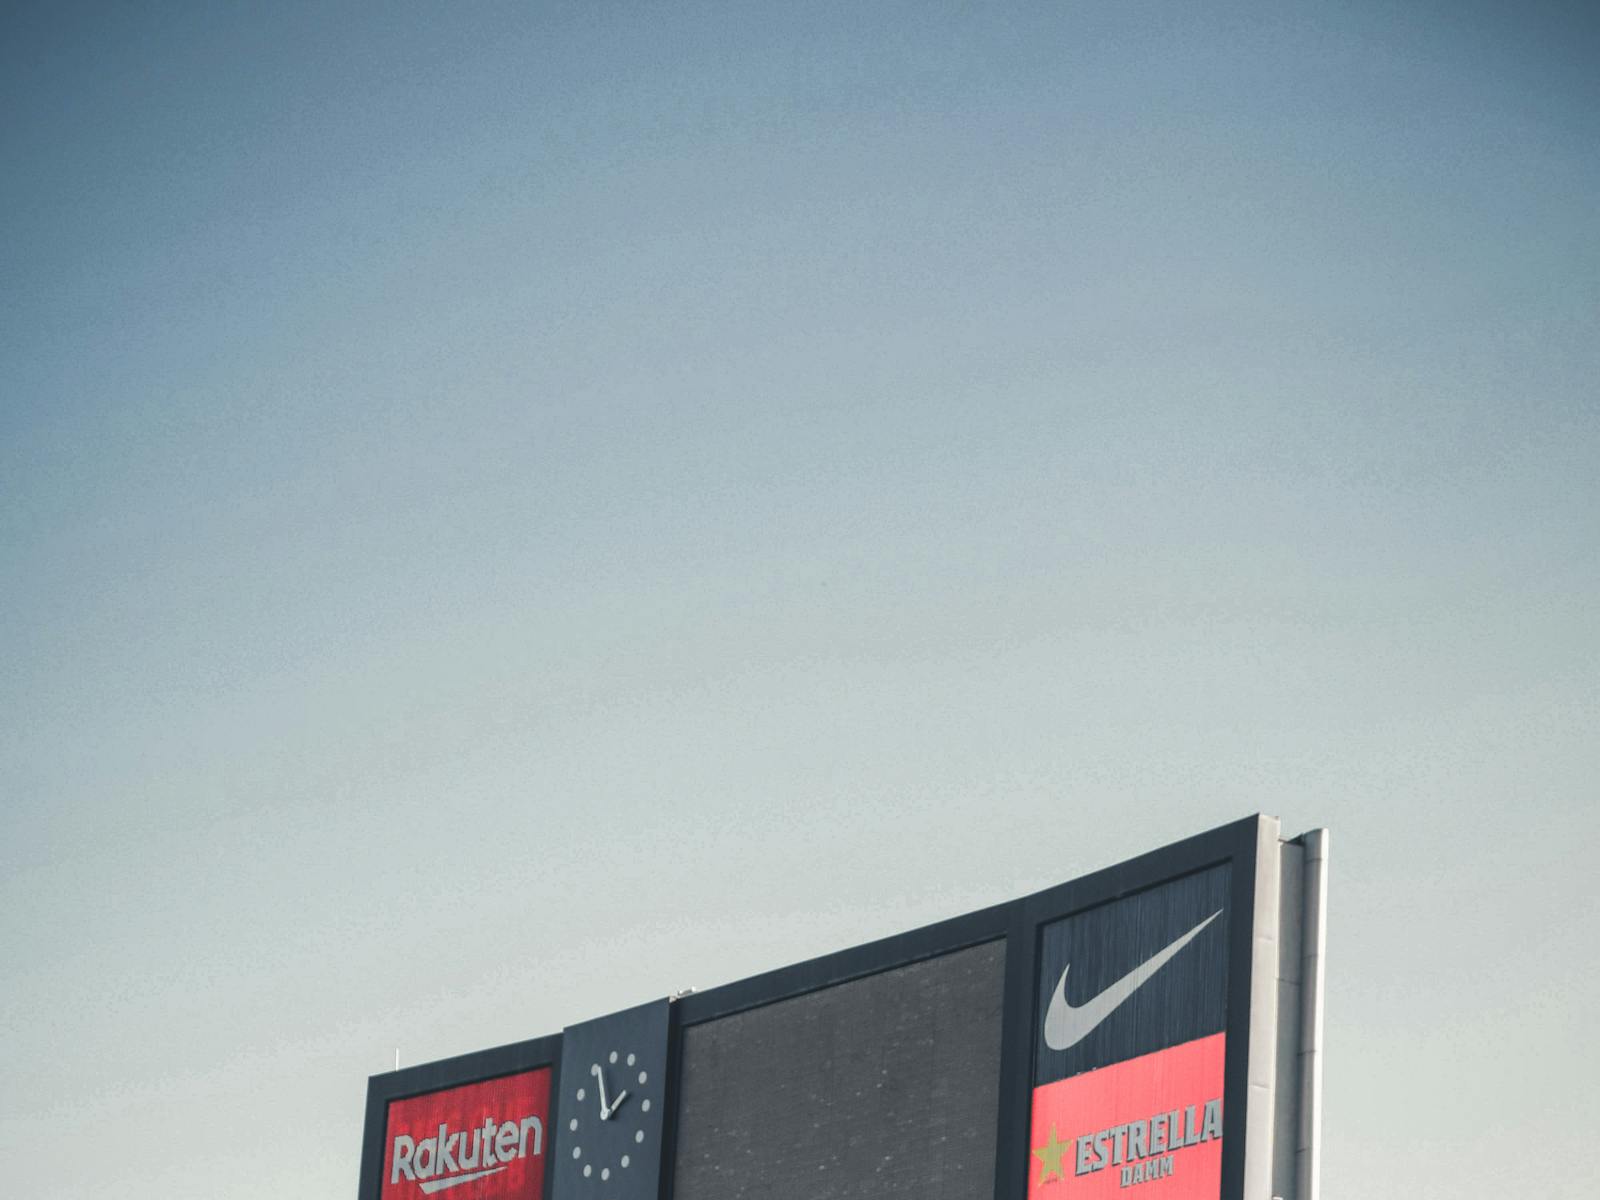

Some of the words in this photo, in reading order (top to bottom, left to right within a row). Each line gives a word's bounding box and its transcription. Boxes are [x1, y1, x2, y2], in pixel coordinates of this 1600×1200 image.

[391, 1115, 542, 1184] Rakuten
[1075, 1099, 1223, 1177] ESTRELLA
[1120, 1154, 1174, 1189] DAMM
